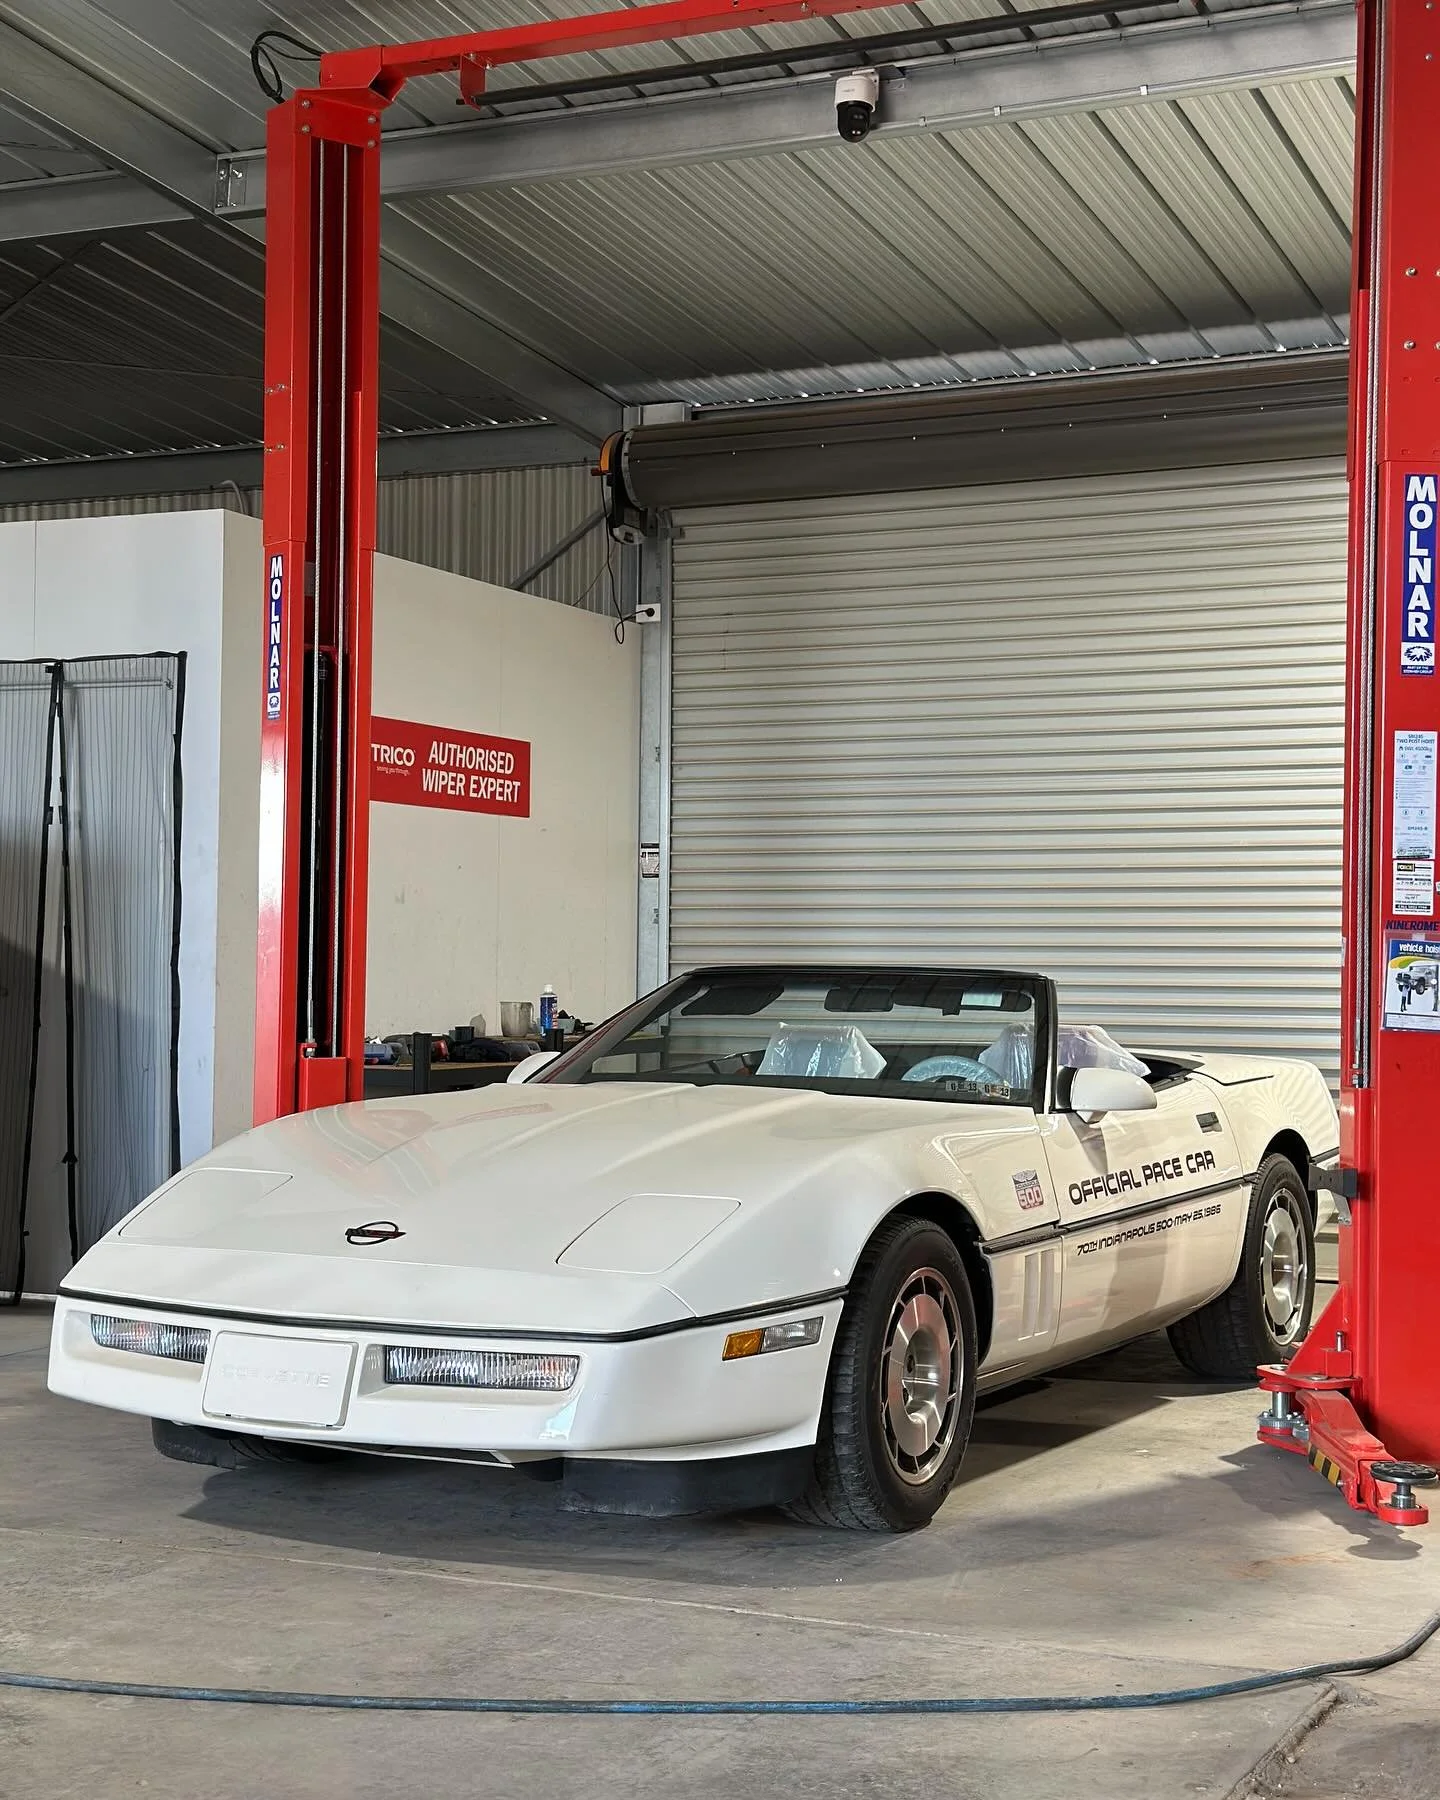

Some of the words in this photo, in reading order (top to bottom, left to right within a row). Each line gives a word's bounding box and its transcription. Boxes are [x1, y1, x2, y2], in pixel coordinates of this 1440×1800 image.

[1406, 476, 1437, 638] MOLNAR
[270, 556, 283, 689] MOLNAR
[371, 744, 415, 767] TRICO
[428, 740, 515, 775] AUTHORISED
[422, 768, 465, 796] WIPER
[469, 775, 521, 803] EXPERT
[1386, 919, 1439, 931] KINCROME
[1399, 943, 1424, 953] vehicle
[1425, 944, 1440, 954] hois
[968, 1083, 977, 1091] 13
[1000, 1087, 1009, 1097] 13
[1068, 1170, 1142, 1205] OFFICIAL
[1141, 1157, 1184, 1186] PACE
[1185, 1150, 1216, 1174] CAR
[1017, 1186, 1043, 1208] 500
[1077, 1241, 1098, 1256] 70TH
[1098, 1223, 1155, 1250] INDIANAPOLIS
